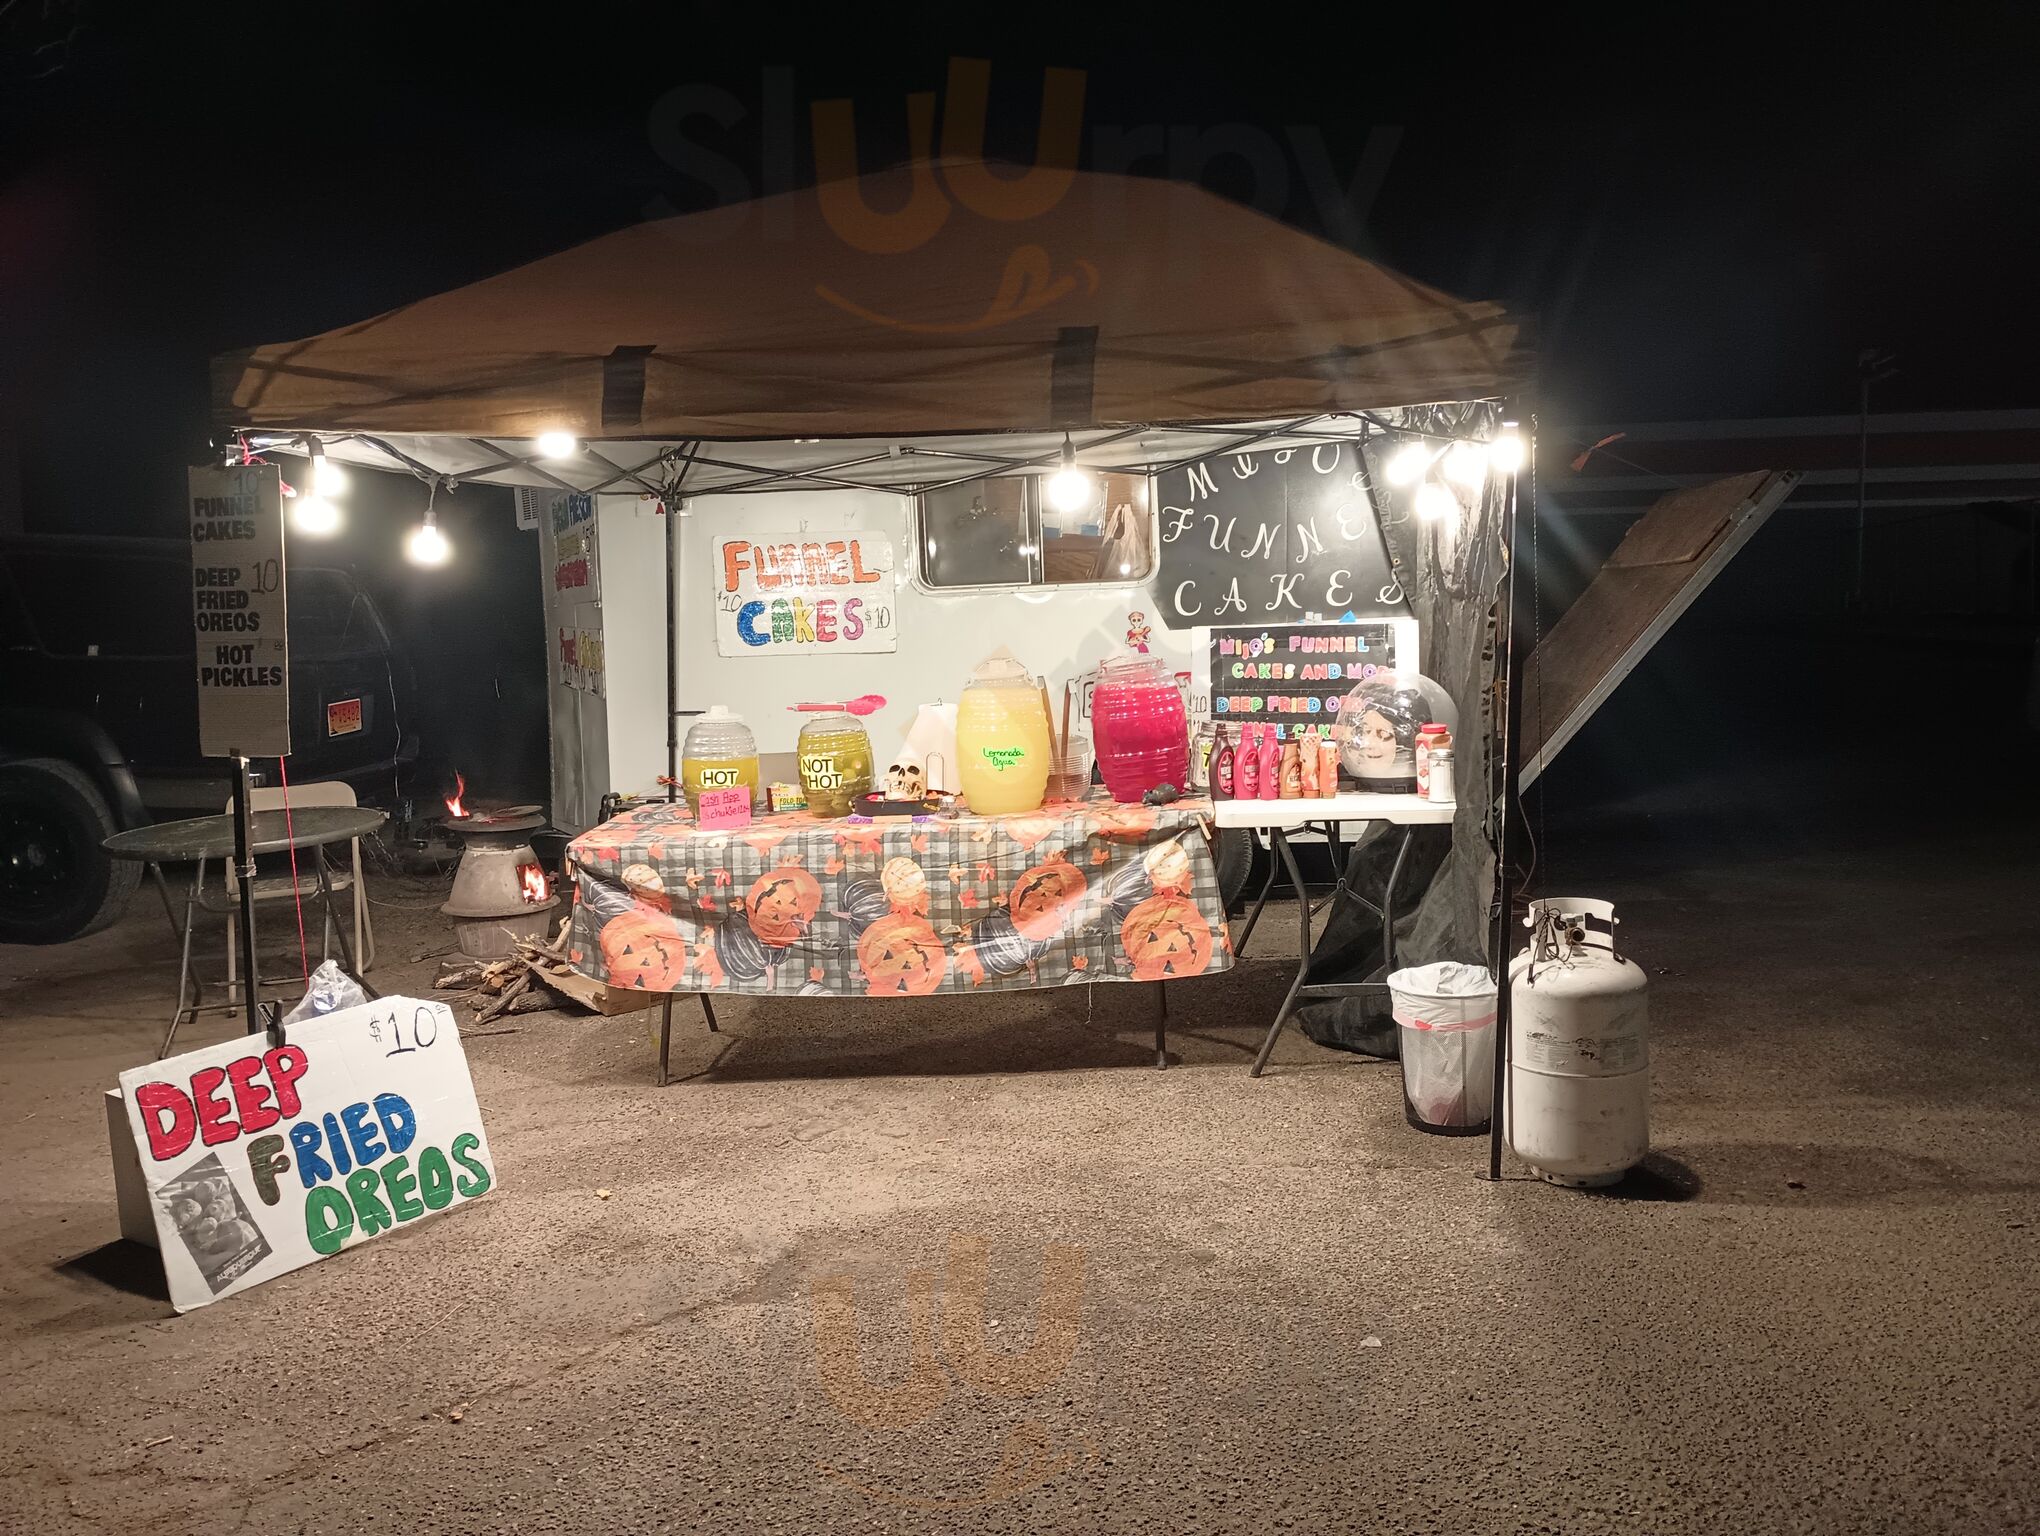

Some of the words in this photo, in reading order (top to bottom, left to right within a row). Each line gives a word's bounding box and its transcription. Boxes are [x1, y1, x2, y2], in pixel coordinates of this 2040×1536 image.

[193, 520, 256, 542] CAKES
[251, 558, 279, 595] 10
[723, 540, 881, 592] FUNNEL
[195, 567, 241, 588] DEEP
[197, 590, 249, 611] FRIED
[717, 590, 743, 613] $10
[1174, 567, 1405, 617] CAKES
[197, 612, 260, 632] OREOS
[737, 597, 864, 647] CAKES
[1289, 635, 1369, 653] FUNNEL
[216, 645, 254, 665] HOT
[201, 667, 282, 687] PICKLES
[1231, 662, 1295, 679] CAKES
[1300, 663, 1342, 680] AND
[1216, 696, 1263, 712] DEEP
[1267, 696, 1321, 713] FRIED
[803, 759, 832, 774] NOT
[703, 771, 737, 785] HOT
[808, 773, 842, 789] HOT
[135, 1043, 309, 1162] DEEP
[246, 1092, 417, 1206] FRIED
[305, 1132, 492, 1256] OREOS
